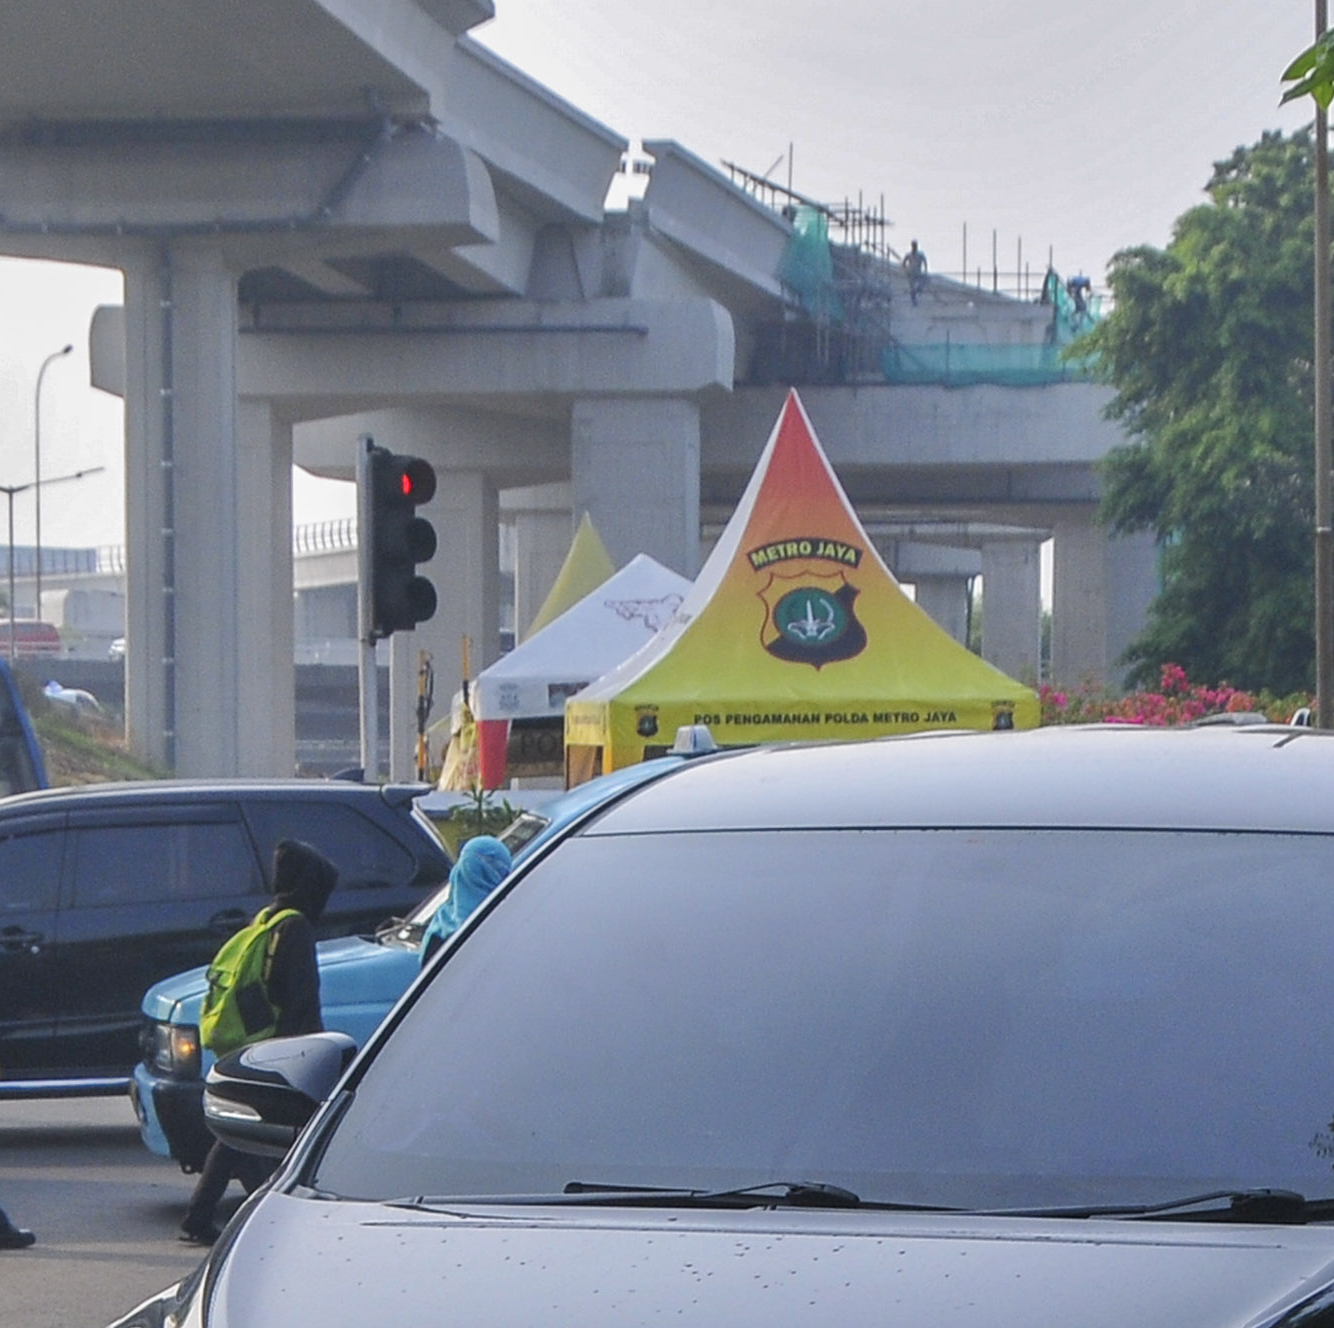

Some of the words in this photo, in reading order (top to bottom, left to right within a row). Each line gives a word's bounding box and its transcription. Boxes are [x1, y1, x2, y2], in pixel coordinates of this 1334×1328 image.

[751, 541, 811, 566] METRO
[817, 541, 856, 563] JAYA
[694, 714, 721, 725] POS
[725, 714, 821, 725] PENGAMANAN
[825, 713, 868, 725] POLDA
[873, 712, 920, 724] METRO
[924, 711, 957, 723] JAYA
